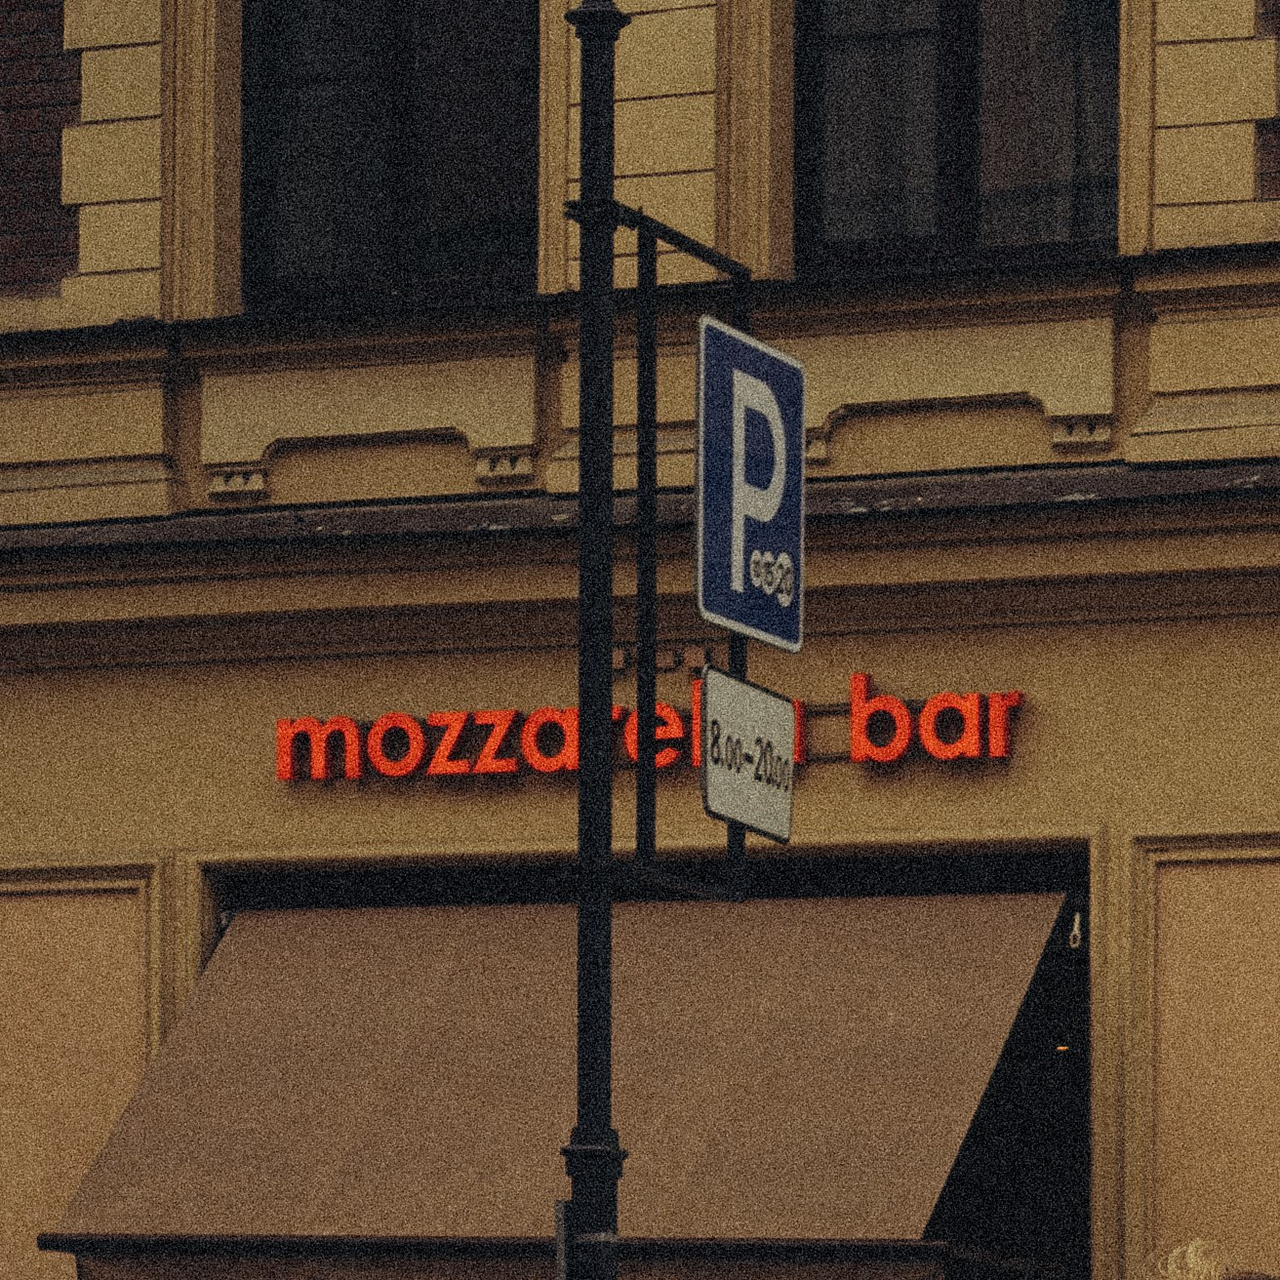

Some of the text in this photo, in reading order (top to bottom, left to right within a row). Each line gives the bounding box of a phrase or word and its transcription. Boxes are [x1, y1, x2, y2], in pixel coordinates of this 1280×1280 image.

[732, 370, 786, 592] P
[276, 673, 1023, 781] mozzael bar
